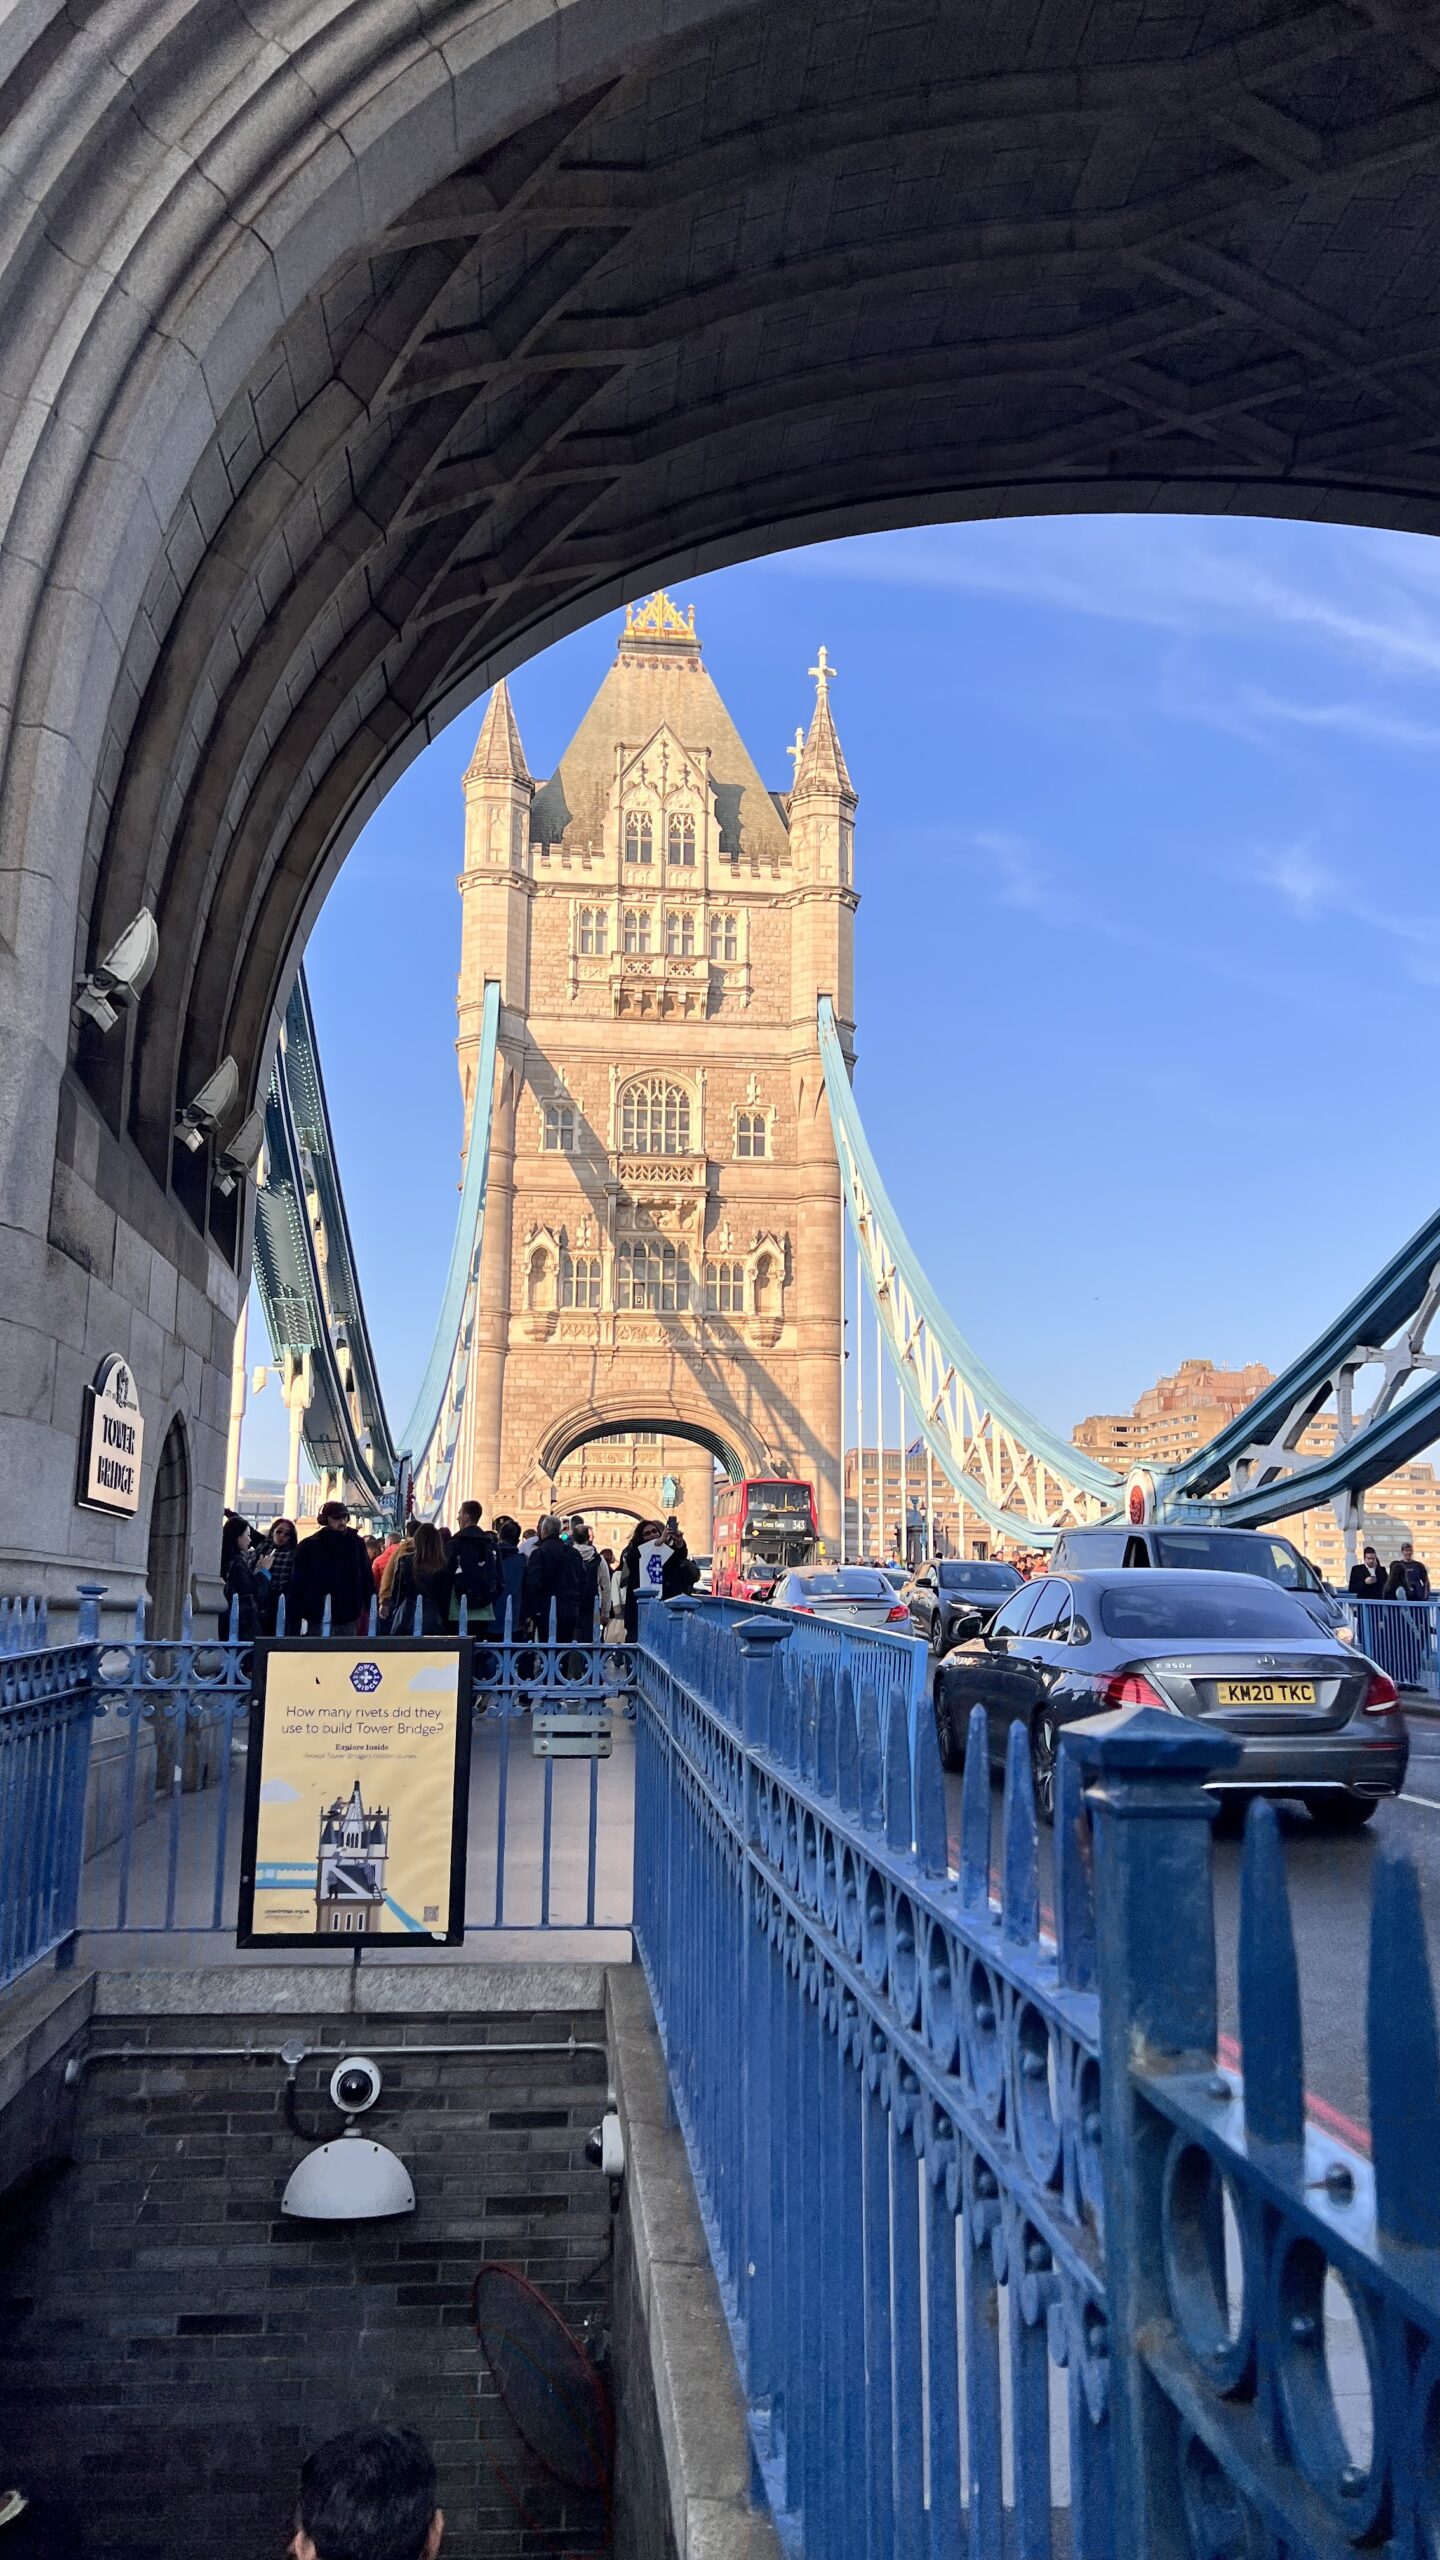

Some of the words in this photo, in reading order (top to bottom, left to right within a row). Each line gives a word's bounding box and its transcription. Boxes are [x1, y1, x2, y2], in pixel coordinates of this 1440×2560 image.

[102, 1414, 135, 1456] TOWER
[97, 1455, 134, 1495] BRIDGE
[792, 1519, 805, 1530] 343
[353, 1664, 378, 1675] TOWER
[353, 1679, 379, 1691] BRIDGE
[1228, 1684, 1274, 1701] KM20
[1278, 1684, 1312, 1701] TKC
[286, 1705, 315, 1717] How
[318, 1708, 351, 1719] many
[355, 1708, 389, 1718] rivets
[392, 1706, 412, 1718] did
[415, 1707, 441, 1719] they
[281, 1724, 303, 1734] use
[306, 1723, 319, 1734] to
[322, 1723, 352, 1734] build
[356, 1722, 393, 1734] Tower
[397, 1722, 444, 1737] Bridge?
[335, 1743, 364, 1752] Explore
[366, 1743, 389, 1751] Inside
